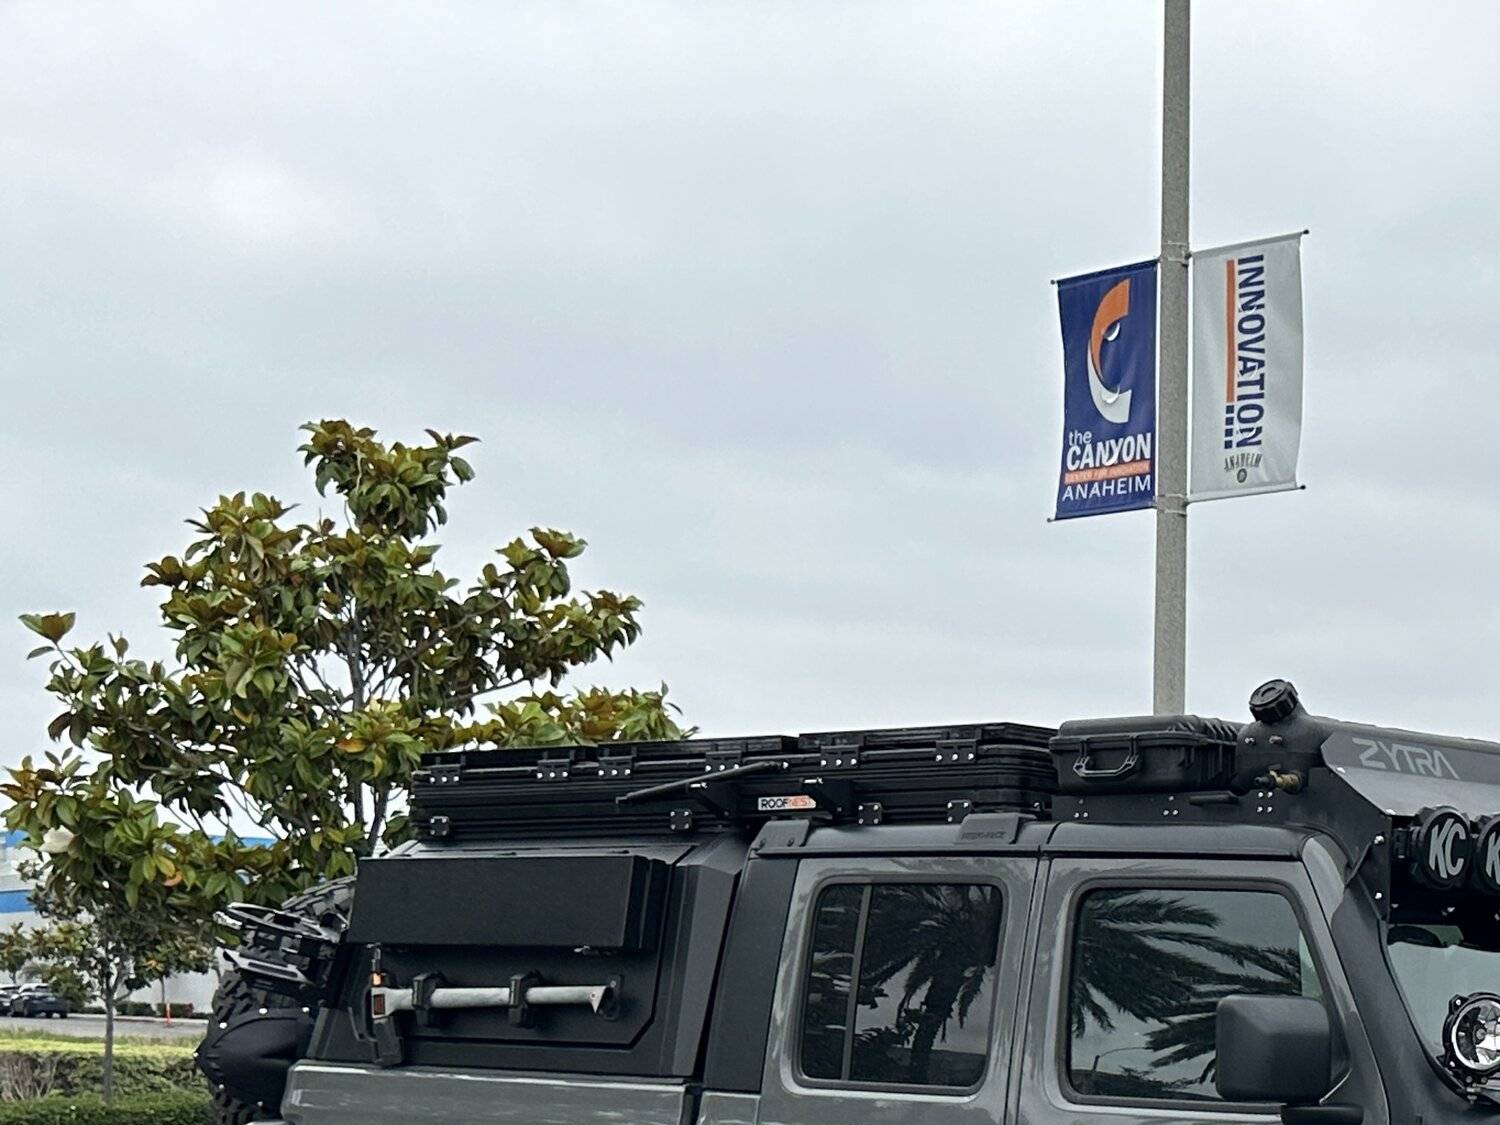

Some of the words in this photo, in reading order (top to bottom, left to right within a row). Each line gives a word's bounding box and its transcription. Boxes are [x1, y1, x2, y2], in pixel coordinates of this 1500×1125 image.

[1235, 254, 1265, 449] INNOVATION
[1066, 432, 1152, 471] CANYON
[1069, 430, 1092, 446] the
[1062, 474, 1151, 501] ANAHEIM
[1352, 737, 1460, 779] ZYTRA
[1428, 818, 1466, 879] KC
